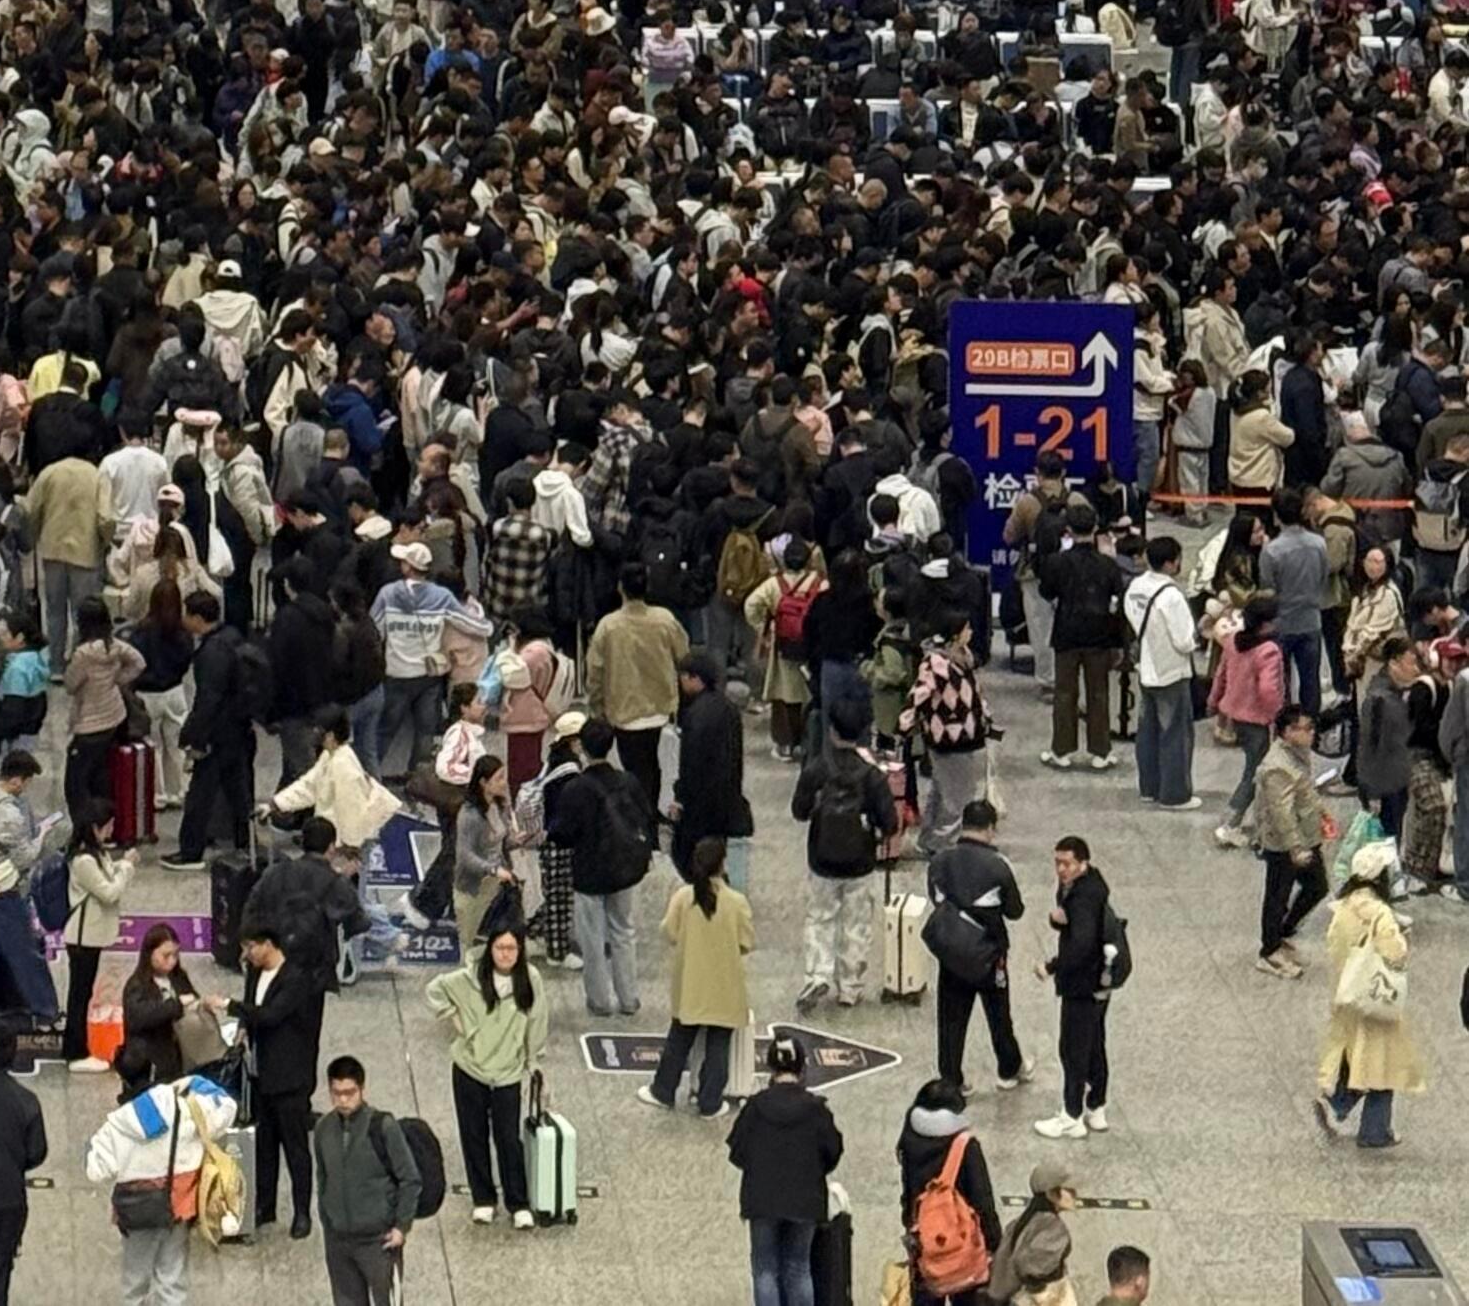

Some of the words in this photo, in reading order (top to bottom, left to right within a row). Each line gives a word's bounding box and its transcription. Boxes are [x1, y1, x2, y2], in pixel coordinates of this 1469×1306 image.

[972, 348, 1070, 370] 29B检票口
[974, 405, 1108, 461] 1-21
